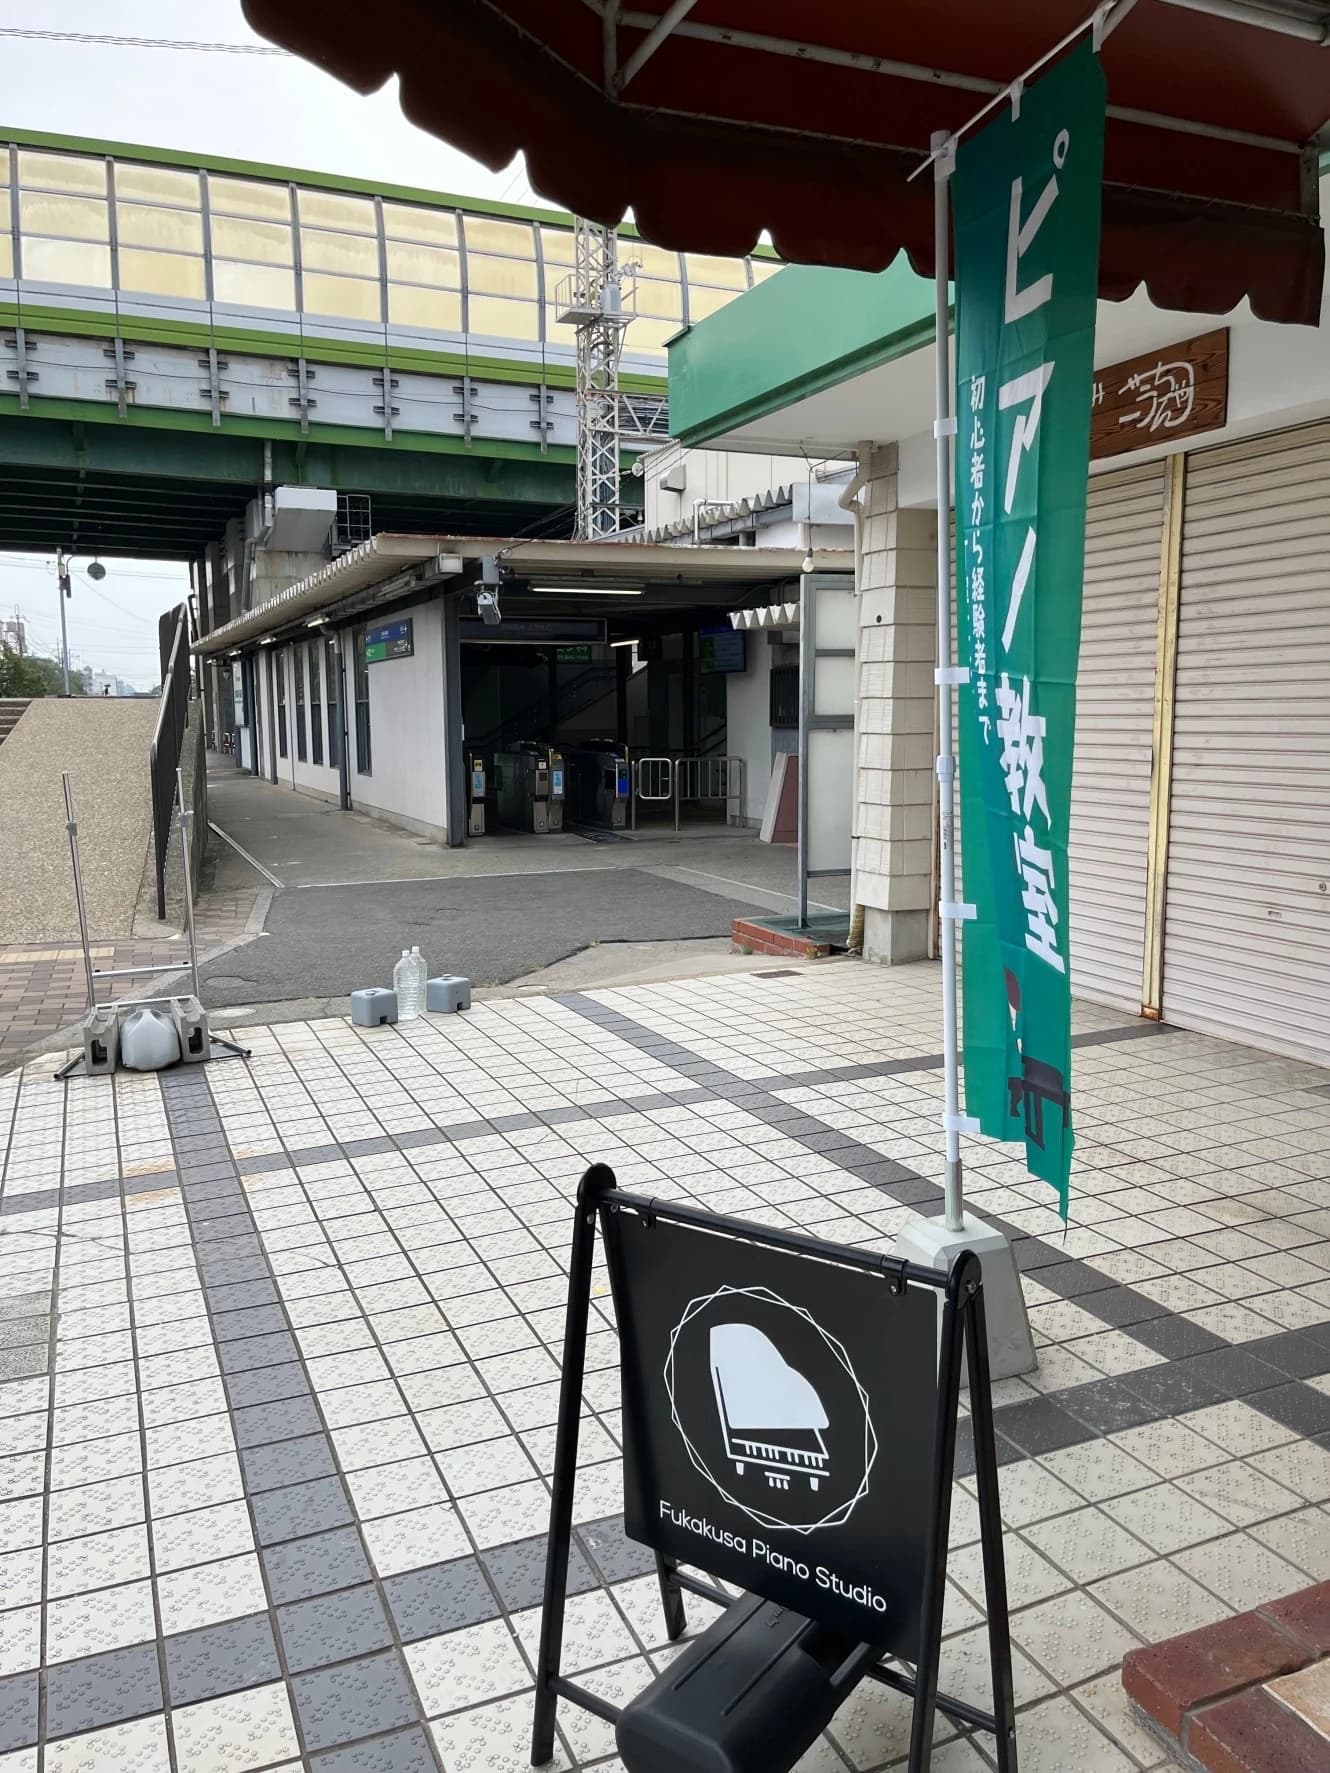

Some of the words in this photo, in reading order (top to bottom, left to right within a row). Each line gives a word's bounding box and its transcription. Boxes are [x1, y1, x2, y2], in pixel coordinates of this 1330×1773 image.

[970, 375, 992, 745] 初心者から経験者まで
[995, 128, 1070, 974] ピアノ教室
[659, 1499, 747, 1554] Fukakusa
[752, 1539, 809, 1580] Piano
[816, 1566, 887, 1612] Studio
